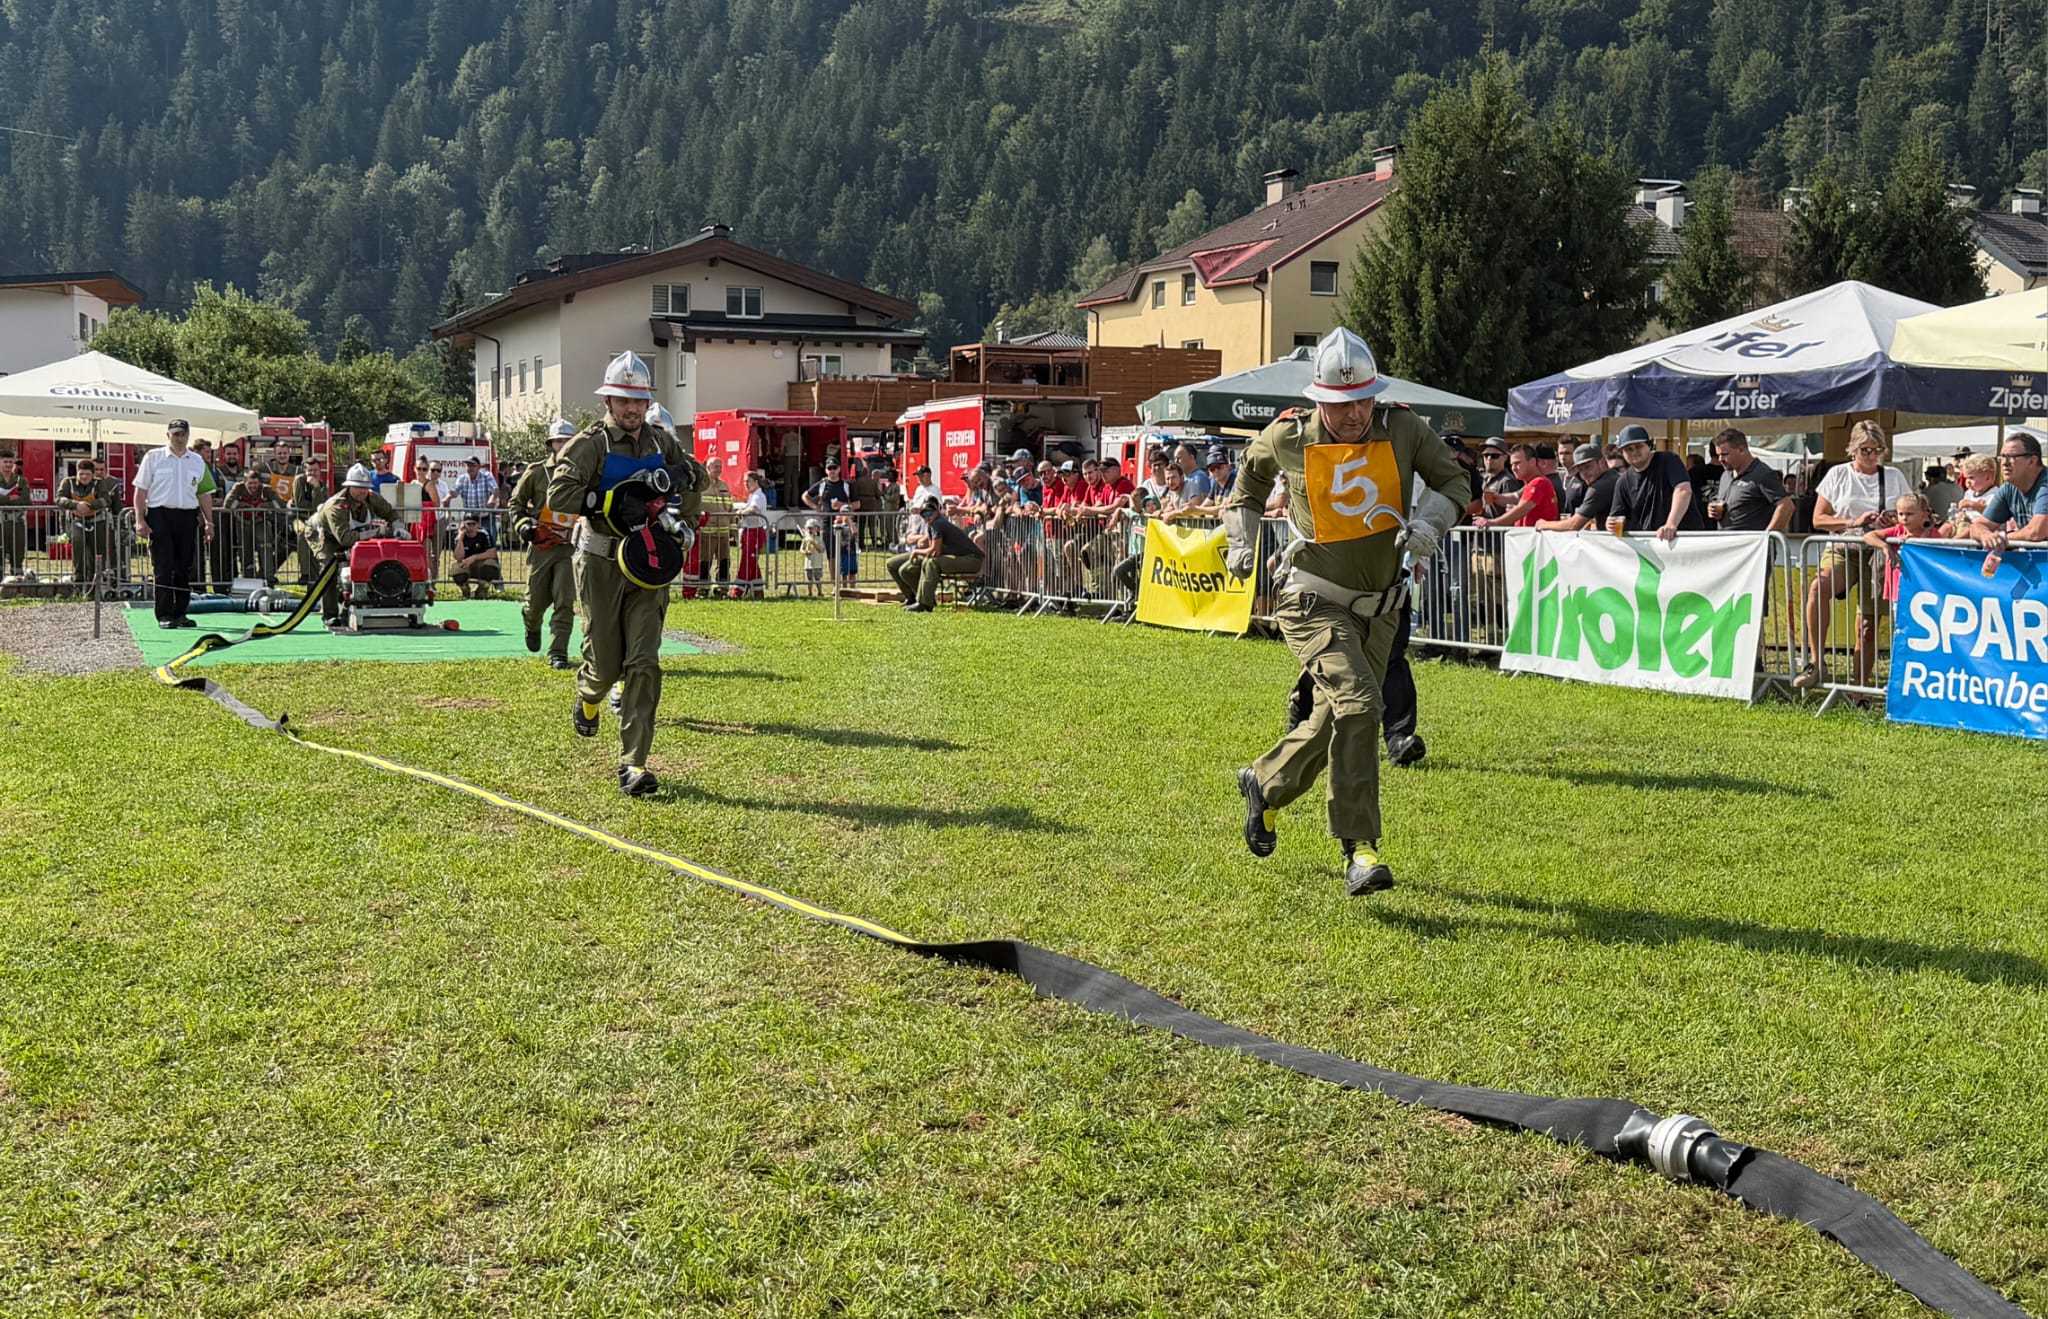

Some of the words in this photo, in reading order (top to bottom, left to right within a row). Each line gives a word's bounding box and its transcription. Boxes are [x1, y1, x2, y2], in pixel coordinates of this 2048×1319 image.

[50, 386, 165, 402] Edelweiss
[1713, 389, 1779, 416] Zipfer
[1231, 399, 1276, 420] Gösser
[1546, 399, 1573, 424] Zipfer
[276, 479, 290, 495] 5
[1330, 455, 1379, 517] 5
